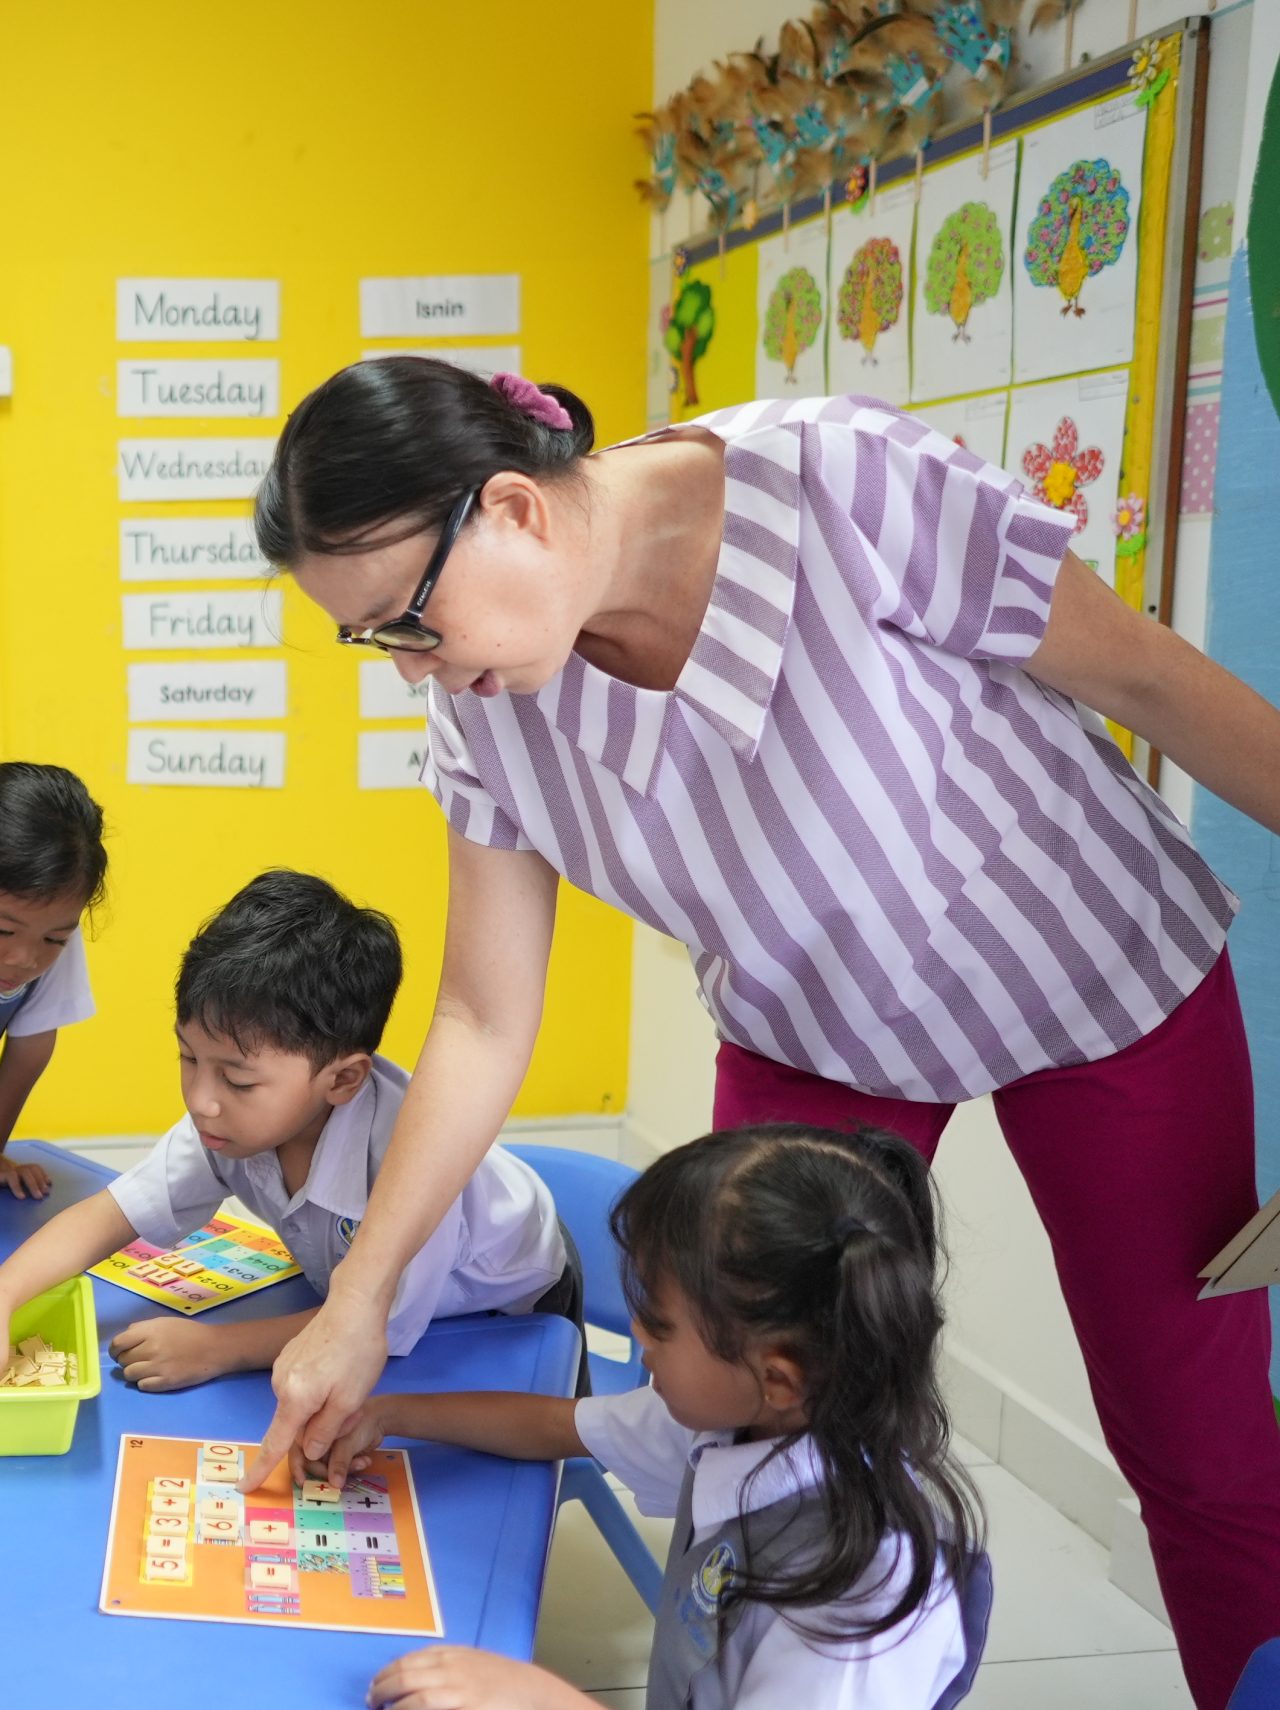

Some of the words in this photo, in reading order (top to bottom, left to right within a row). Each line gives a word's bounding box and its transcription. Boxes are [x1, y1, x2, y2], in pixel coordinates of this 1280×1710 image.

[134, 291, 261, 341] Monday
[415, 299, 465, 321] Isnin
[131, 368, 266, 418] Tuesday
[125, 530, 259, 564] Thursda
[148, 600, 256, 646] Friday
[159, 683, 255, 706] Saturday
[146, 739, 266, 787] Sunday
[168, 1285, 207, 1302] 10+1=
[196, 1276, 234, 1292] 10+2=
